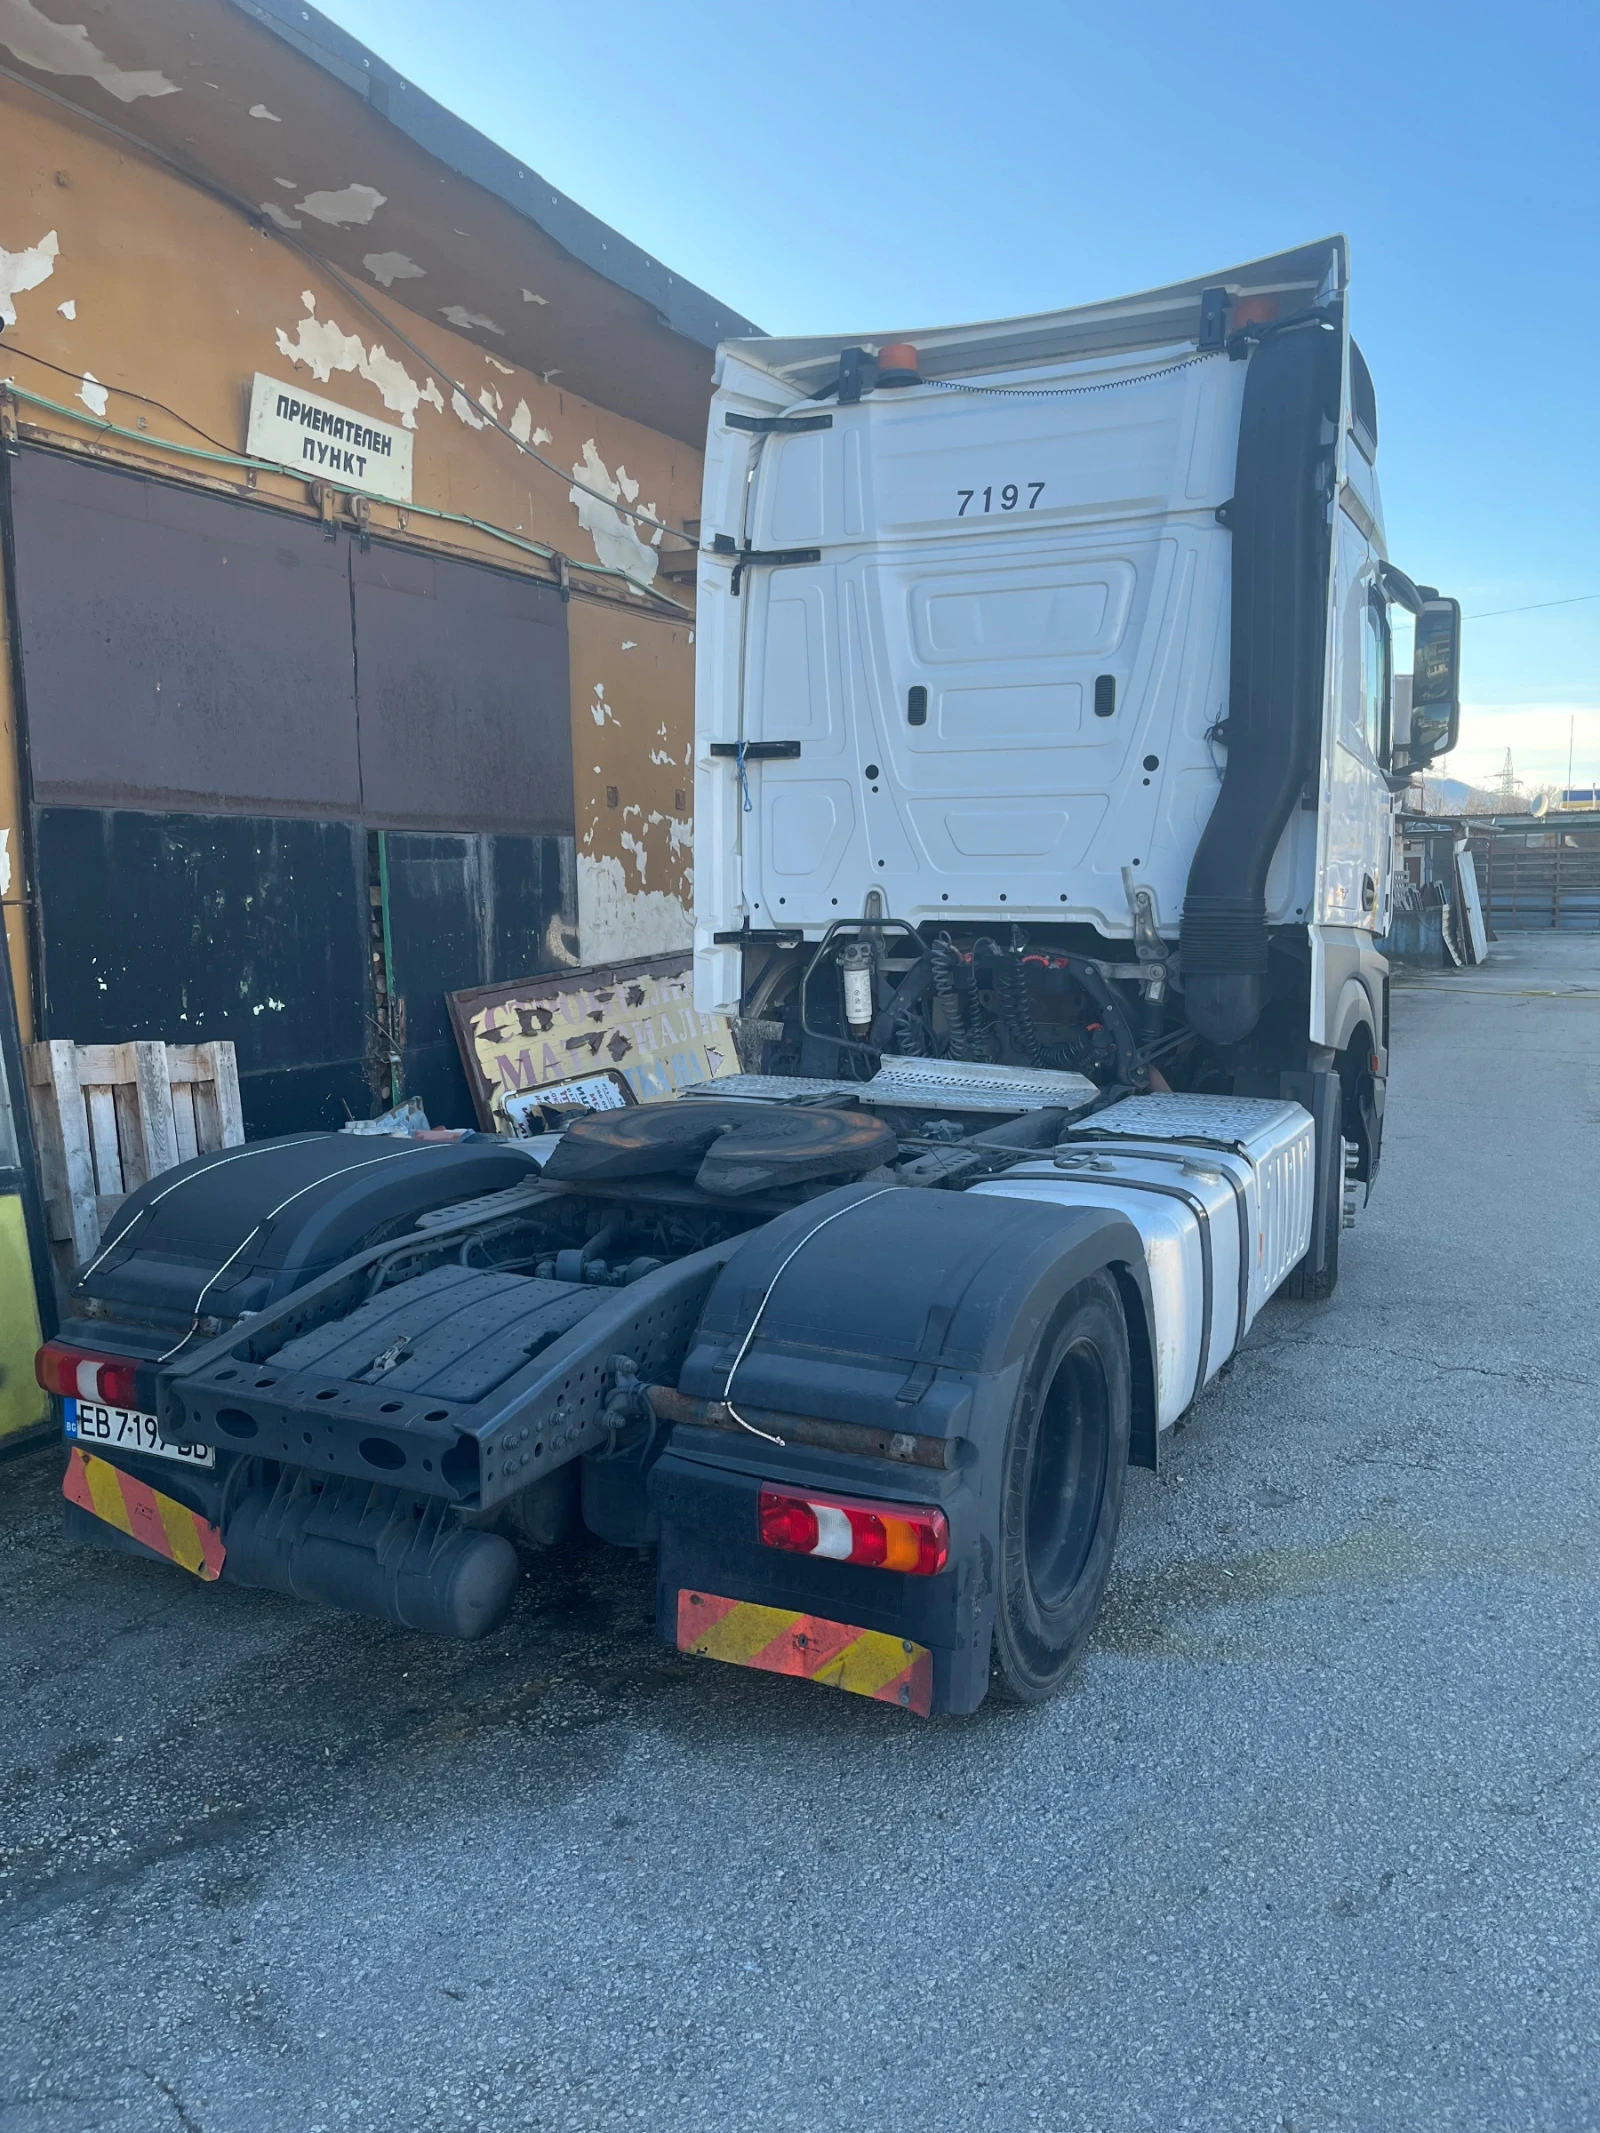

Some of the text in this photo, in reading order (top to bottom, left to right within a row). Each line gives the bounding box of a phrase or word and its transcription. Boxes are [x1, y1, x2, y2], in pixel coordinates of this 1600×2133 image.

[276, 394, 392, 457] ПРИЕМАТЕЛЕН
[302, 437, 367, 477] ПУНКТ
[957, 482, 1046, 516] 7197
[66, 1421, 77, 1432] BG
[80, 1404, 111, 1439] EB
